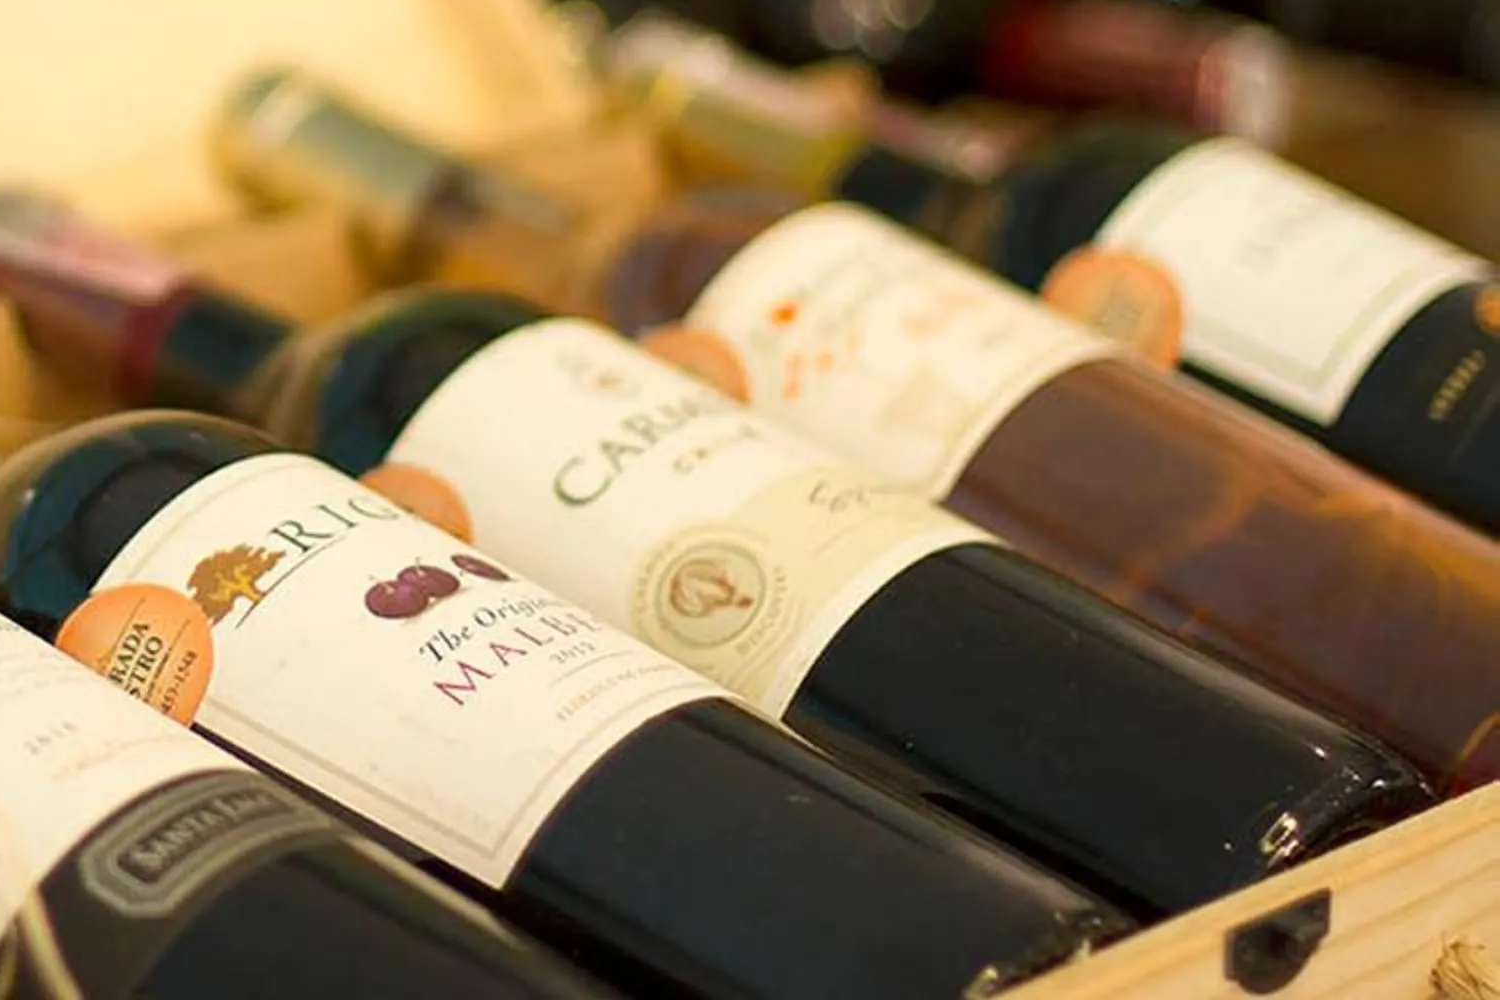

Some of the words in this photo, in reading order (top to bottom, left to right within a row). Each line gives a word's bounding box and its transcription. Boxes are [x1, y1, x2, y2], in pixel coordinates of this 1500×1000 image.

[108, 622, 151, 684] RADA
[128, 635, 164, 699] STRO
[419, 624, 474, 663] The
[432, 612, 602, 706] MALBE
